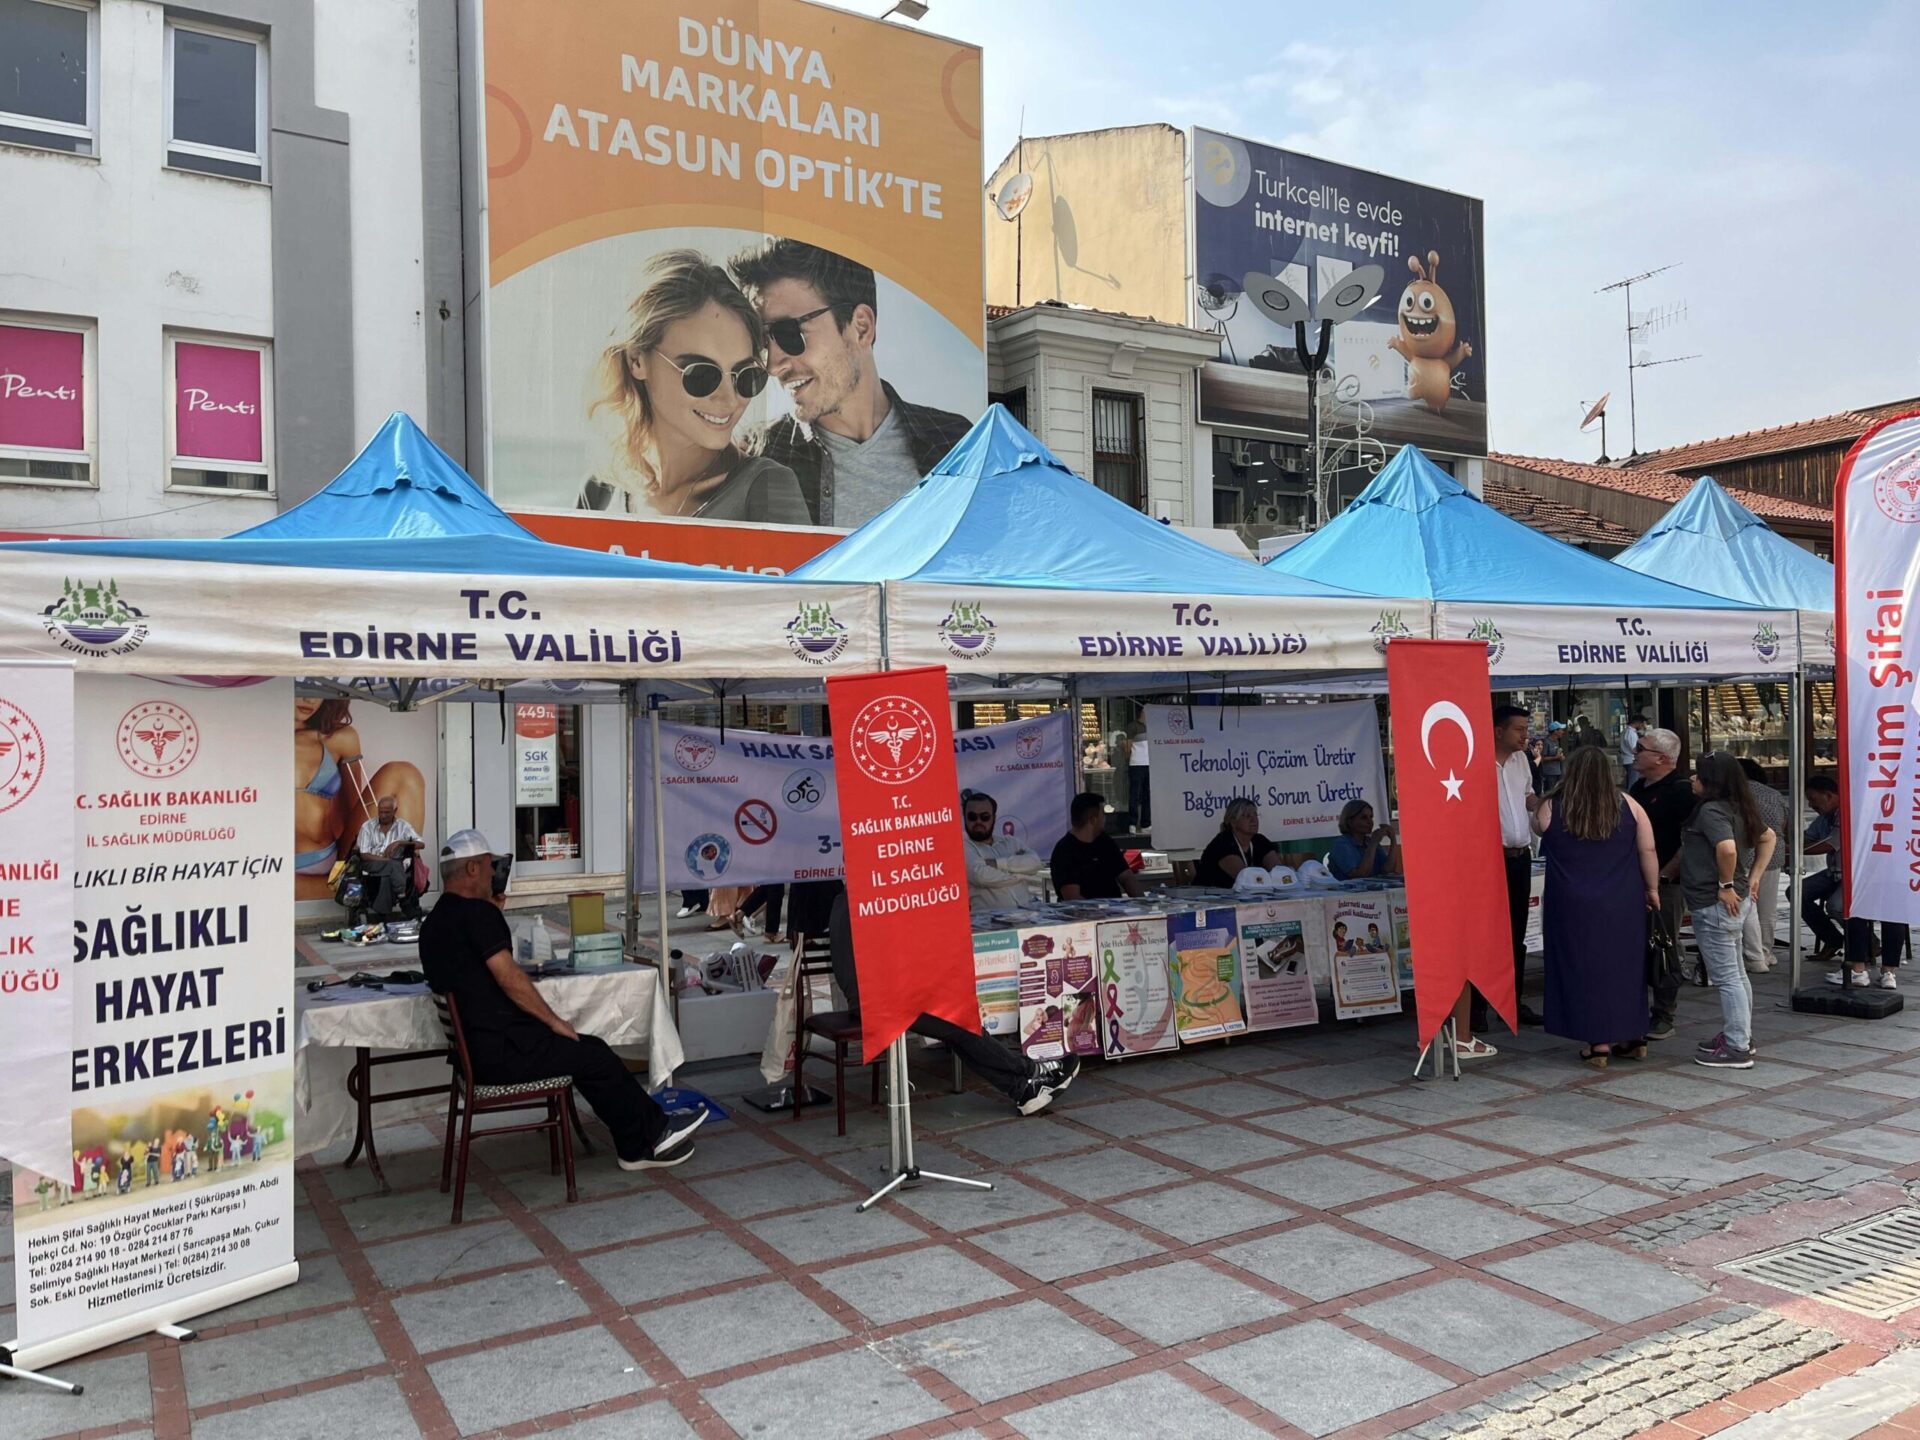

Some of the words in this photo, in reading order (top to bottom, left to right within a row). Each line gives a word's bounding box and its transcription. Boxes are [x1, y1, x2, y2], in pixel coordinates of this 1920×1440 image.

[678, 16, 831, 89] DÜNYA
[621, 54, 880, 147] MARKALARI
[543, 103, 741, 180] ATASUN
[754, 148, 943, 219] OPTİK'TE
[1255, 170, 1350, 214] Turkcell'le
[1357, 200, 1402, 226] evde
[1255, 202, 1339, 244] internet
[1344, 223, 1400, 258] keyfi!
[0, 374, 76, 400] Penti
[184, 388, 255, 415] Penti
[460, 589, 541, 620] T.C.
[1172, 603, 1219, 627] T.C.
[1616, 617, 1652, 636] T.C.
[1866, 589, 1913, 688] Şifai
[59, 638, 109, 658] Edirne
[300, 625, 477, 660] EDİRNE
[505, 628, 682, 663] VALİLİĞİ
[793, 649, 824, 665] Edirne
[1078, 631, 1184, 657] EDİRNE
[1197, 632, 1308, 657] VALİLİĞİ
[1558, 640, 1627, 663] EDİRNE
[1636, 641, 1709, 663] VALİLİĞİ
[525, 751, 548, 762] SGK
[740, 742, 806, 759] HALK
[1180, 749, 1250, 778] Teknoloji
[1257, 749, 1308, 775] Çözüm
[1313, 744, 1356, 765] Üretir
[666, 776, 695, 785] SAĞLIK
[697, 775, 738, 784] BAKANLIĞI
[1868, 704, 1905, 853] Hekim
[98, 790, 161, 809] SAĞLIK
[167, 786, 257, 806] BAKANLIĞI
[892, 795, 912, 809] T.C.
[1183, 785, 1262, 818] Bağımllk
[1268, 786, 1310, 806] Sorun
[1316, 780, 1364, 803] Üretir
[140, 812, 187, 826] EDİRNE
[851, 818, 892, 836] SAĞLIK
[895, 807, 953, 830] BAKANLIĞI
[87, 833, 98, 847] İL
[102, 832, 149, 847] SAĞLIK
[153, 827, 236, 844] MÜDÜRLÜĞÜ
[877, 837, 935, 859] EDİRNE
[132, 862, 167, 884] BİR
[172, 860, 239, 881] HAYAT
[242, 855, 283, 879] İÇİN
[794, 868, 834, 880] EDİRNE
[872, 870, 887, 887] İL
[890, 862, 944, 885] SAĞLIK
[859, 883, 960, 917] MÜDÜRLÜĞÜ
[96, 967, 224, 1024] HAYAT
[72, 1007, 285, 1092] ERKEZLERİ
[28, 1234, 59, 1248] Hekim
[87, 1216, 121, 1234] Sağlıklı
[124, 1211, 150, 1224] Hayat
[152, 1201, 186, 1217] Merkezi
[195, 1188, 240, 1208] Şükrüpaşa
[243, 1184, 258, 1193] Mh.
[260, 1177, 279, 1189] Abdi
[29, 1249, 58, 1265] İpekçi
[61, 1243, 77, 1255] Cd.
[80, 1239, 97, 1250] No:
[100, 1235, 111, 1245] 19
[113, 1227, 141, 1242] Özgür
[144, 1216, 184, 1236] Çocuklar
[186, 1211, 208, 1223] Parkı
[211, 1203, 240, 1217] Karşısı
[29, 1267, 47, 1279] Tel:
[50, 1259, 73, 1273] 0284
[75, 1254, 92, 1266] 214
[95, 1250, 106, 1260] 90
[109, 1247, 120, 1256] 18
[128, 1239, 150, 1252] 0284
[152, 1234, 168, 1245] 214
[170, 1230, 180, 1240] 87
[183, 1227, 193, 1237] 76
[30, 1275, 72, 1293] Selimiye
[74, 1265, 109, 1281] Sağlıklı
[112, 1257, 138, 1271] Hayat
[141, 1247, 175, 1263] Merkezi
[233, 1225, 252, 1237] Mah.
[255, 1218, 280, 1232] Çukur
[30, 1297, 52, 1309] Sok.
[55, 1287, 76, 1301] Eski
[79, 1279, 109, 1295] Devlet
[111, 1268, 156, 1286] Hastanesi
[165, 1259, 180, 1270] Tel:
[183, 1250, 209, 1265] 0(284)
[211, 1245, 226, 1257] 214
[228, 1242, 239, 1252] 30
[240, 1238, 250, 1248] 08
[88, 1279, 164, 1309] Hizmetlerimiz
[167, 1261, 226, 1287] Ücretsizdir.
